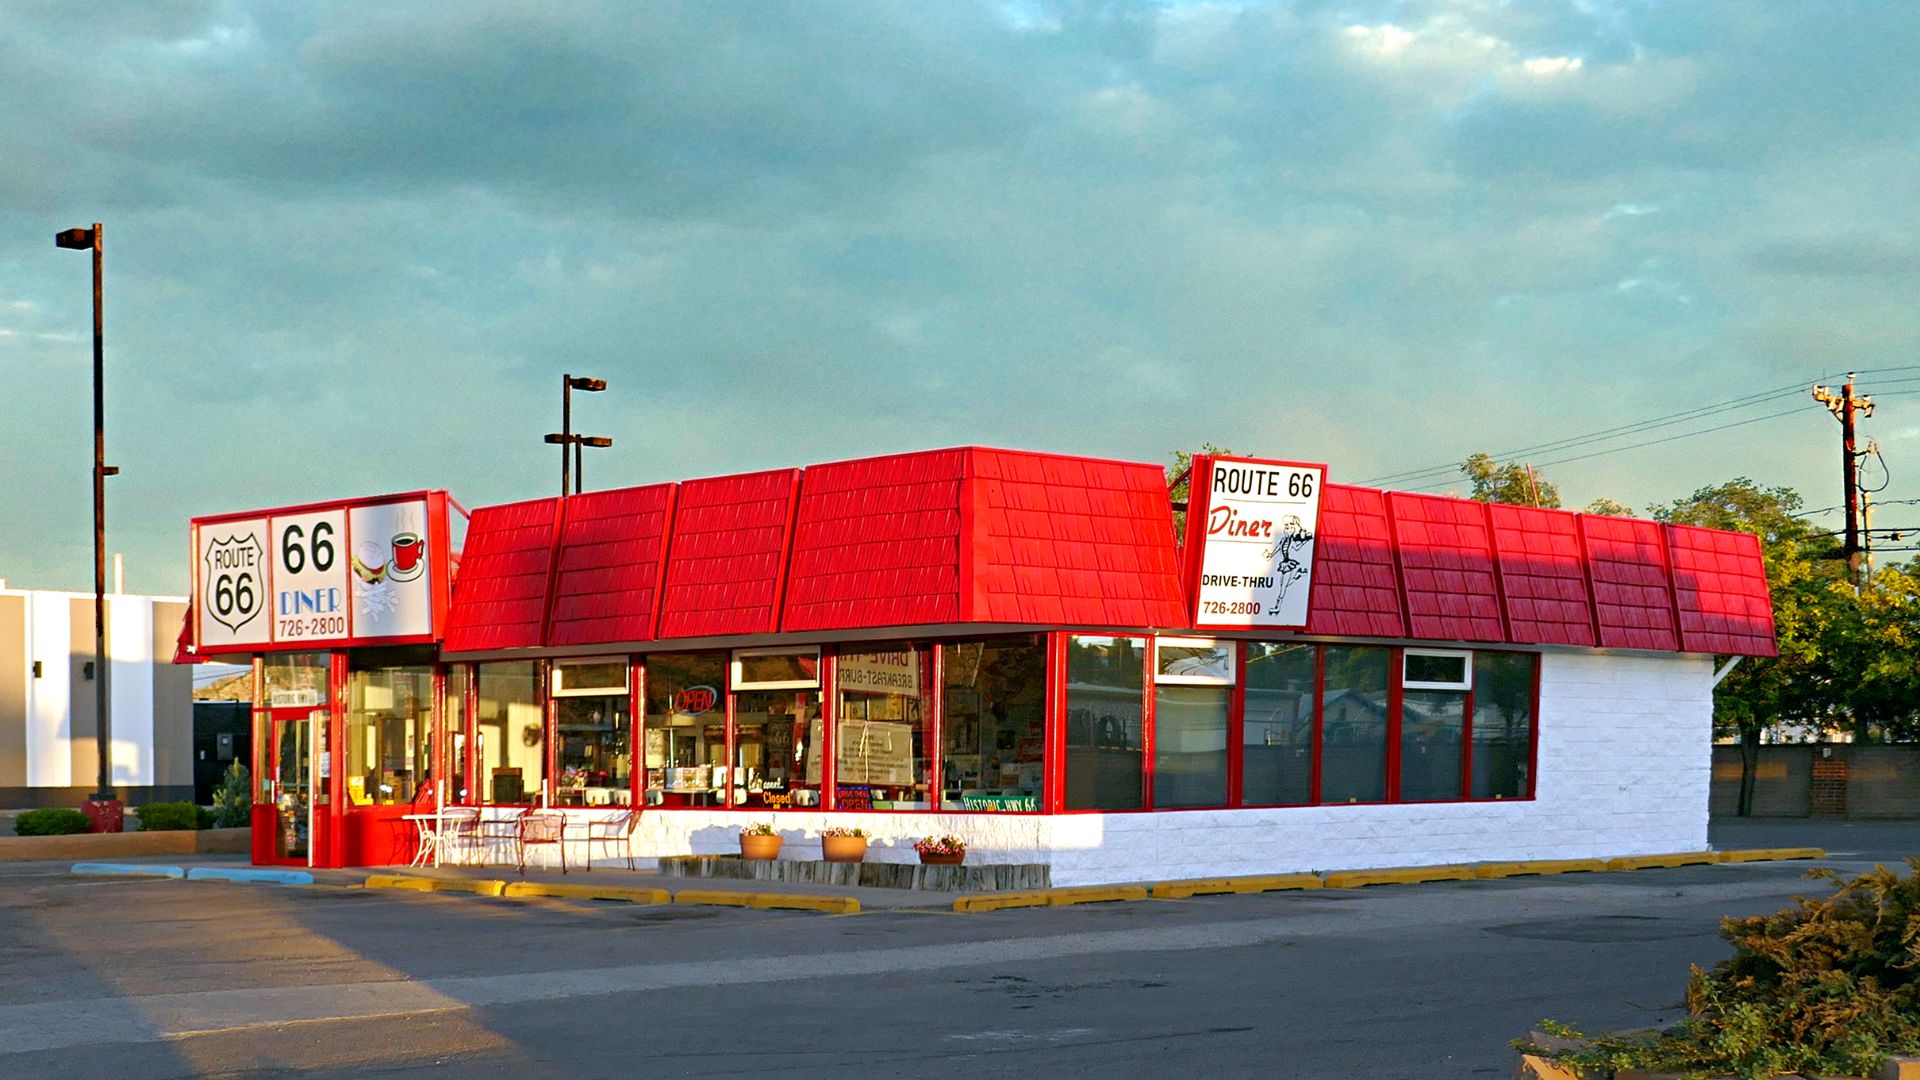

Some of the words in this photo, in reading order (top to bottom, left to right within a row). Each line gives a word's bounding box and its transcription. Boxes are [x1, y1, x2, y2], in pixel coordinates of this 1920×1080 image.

[1213, 467, 1280, 496] ROUTE
[1288, 473, 1314, 498] 66
[1207, 505, 1273, 537] Diner
[215, 546, 254, 569] ROUTE
[282, 521, 335, 574] 66
[1202, 574, 1274, 589] DRIVE-THRU
[215, 572, 254, 616] 66
[280, 587, 342, 616] DINER
[1203, 601, 1261, 616] 726-2800
[279, 616, 345, 637] 726-2800
[674, 688, 713, 712] OPEN
[763, 791, 791, 804] Closed
[841, 799, 868, 809] OPEN
[1024, 798, 1038, 812] 66
